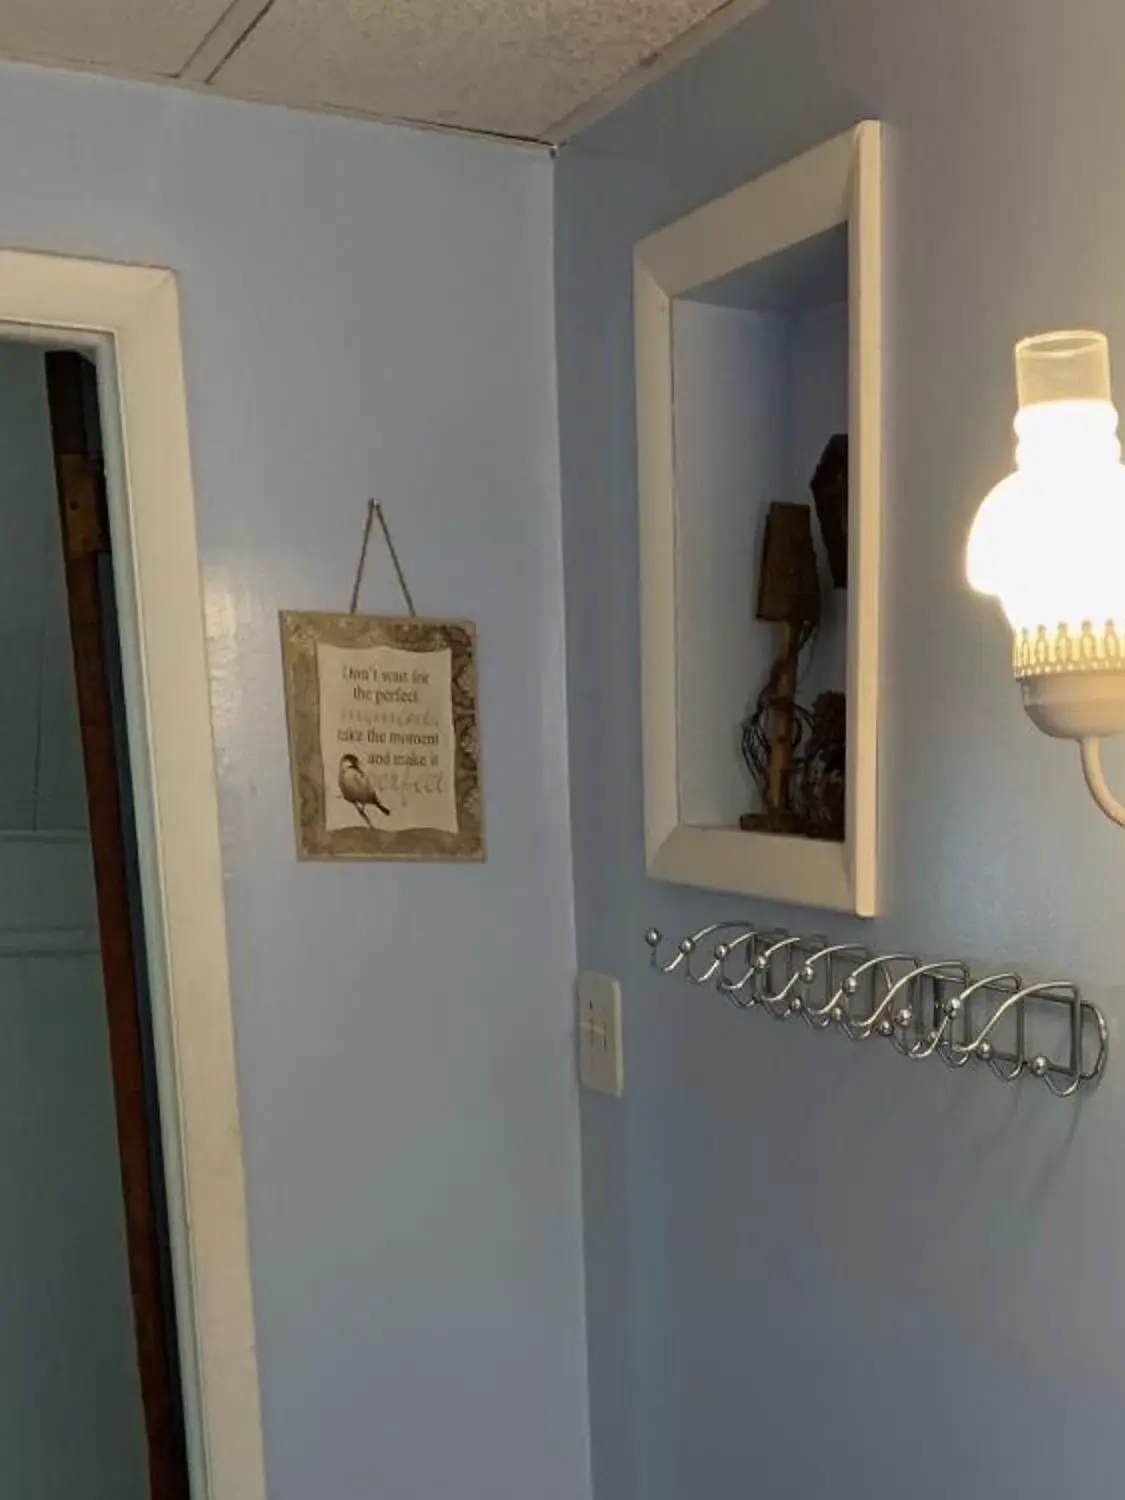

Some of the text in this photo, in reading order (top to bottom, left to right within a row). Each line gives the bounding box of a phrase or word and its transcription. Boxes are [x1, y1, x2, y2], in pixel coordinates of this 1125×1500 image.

[341, 664, 430, 685] Don't wait for
[353, 684, 420, 705] the perfect
[337, 727, 438, 746] take the moment
[367, 749, 439, 767] and make it
